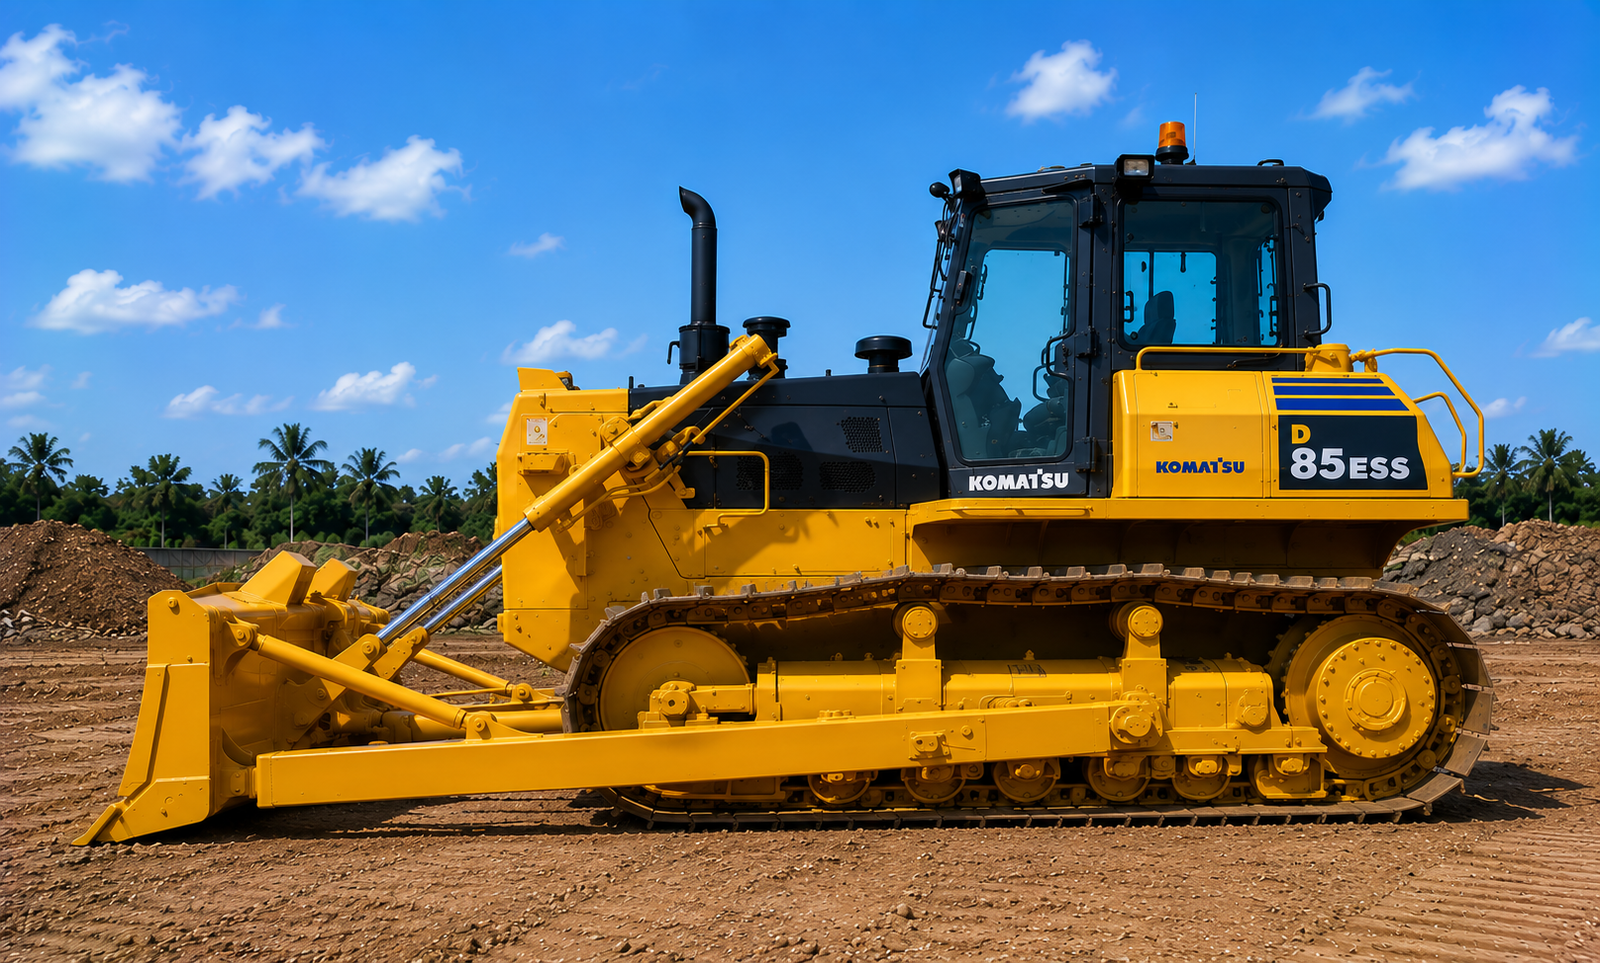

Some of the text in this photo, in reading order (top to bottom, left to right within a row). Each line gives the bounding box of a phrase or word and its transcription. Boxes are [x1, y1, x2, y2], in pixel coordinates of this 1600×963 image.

[1291, 424, 1311, 444] D
[1156, 457, 1245, 474] KOMATSU
[968, 468, 1069, 491] KOMATSU
